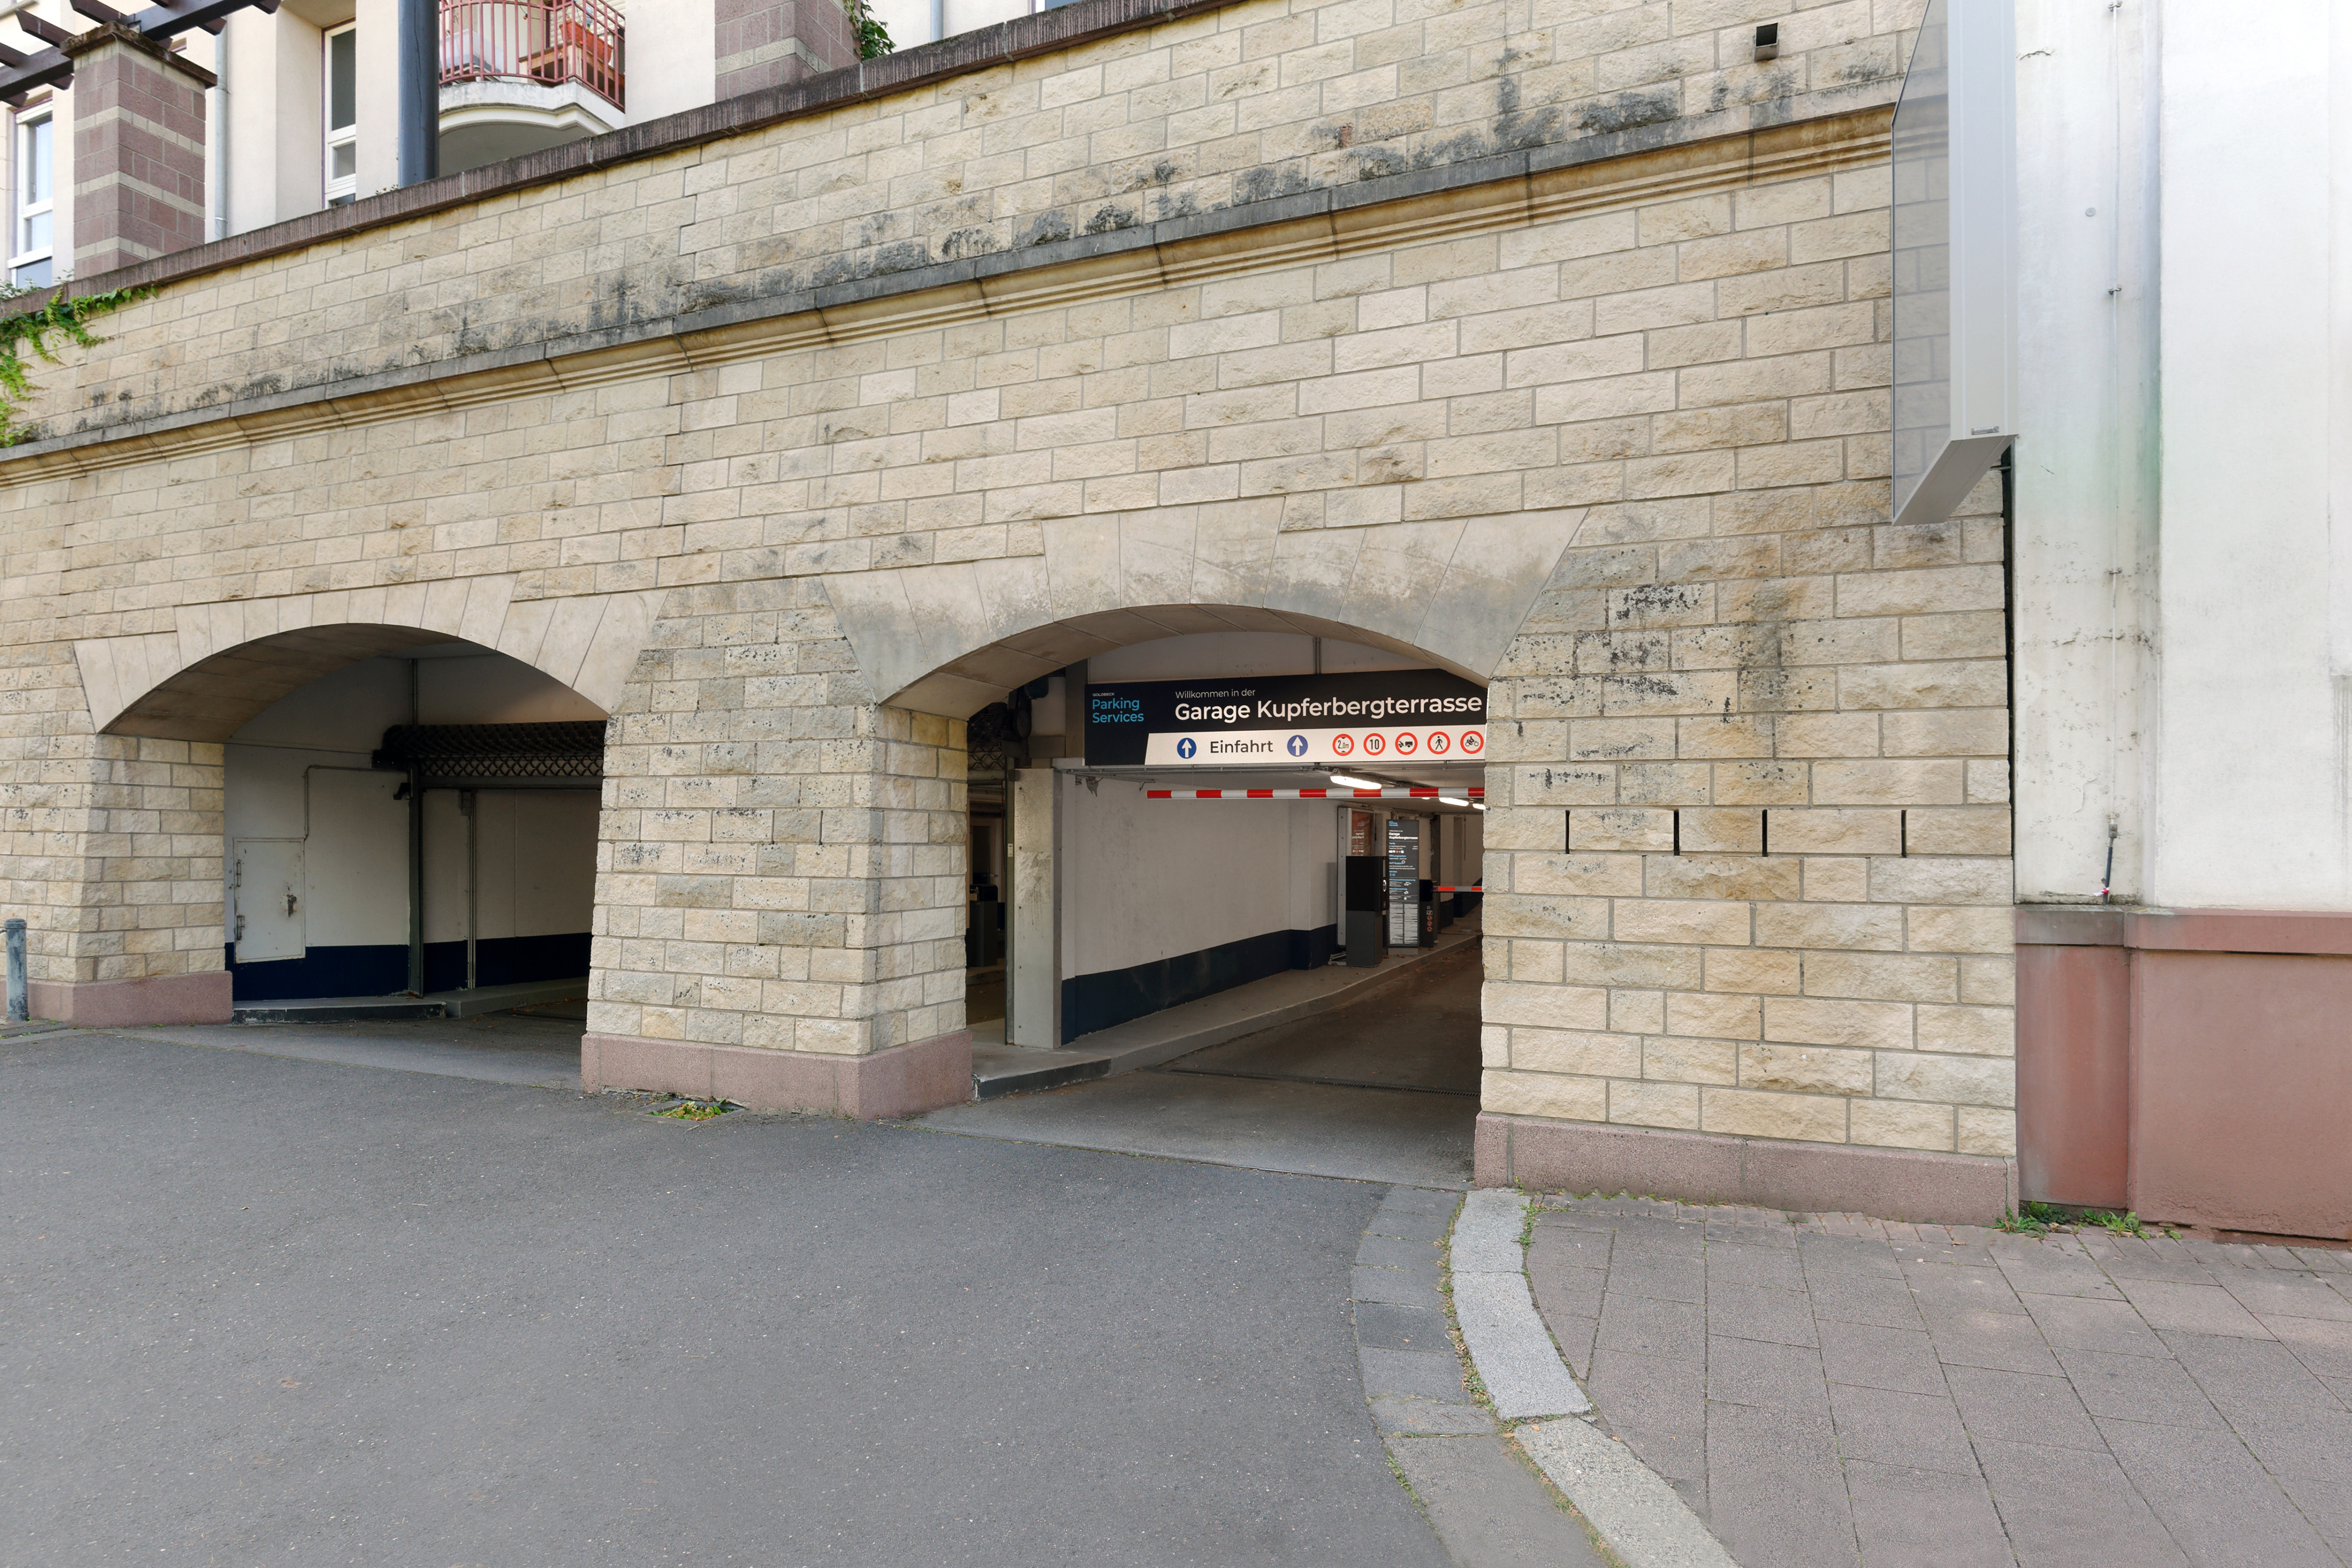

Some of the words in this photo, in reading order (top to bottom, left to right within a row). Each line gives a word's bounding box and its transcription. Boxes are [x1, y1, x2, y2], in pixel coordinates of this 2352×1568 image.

[1175, 690, 1229, 699] Willkommen
[1092, 697, 1140, 711] Parking
[1175, 703, 1250, 723] Garage
[1257, 697, 1482, 722] Kupferbergterrasse
[1092, 711, 1144, 723] Services
[1210, 740, 1273, 753] Einfahrt
[1369, 739, 1379, 750] 10
